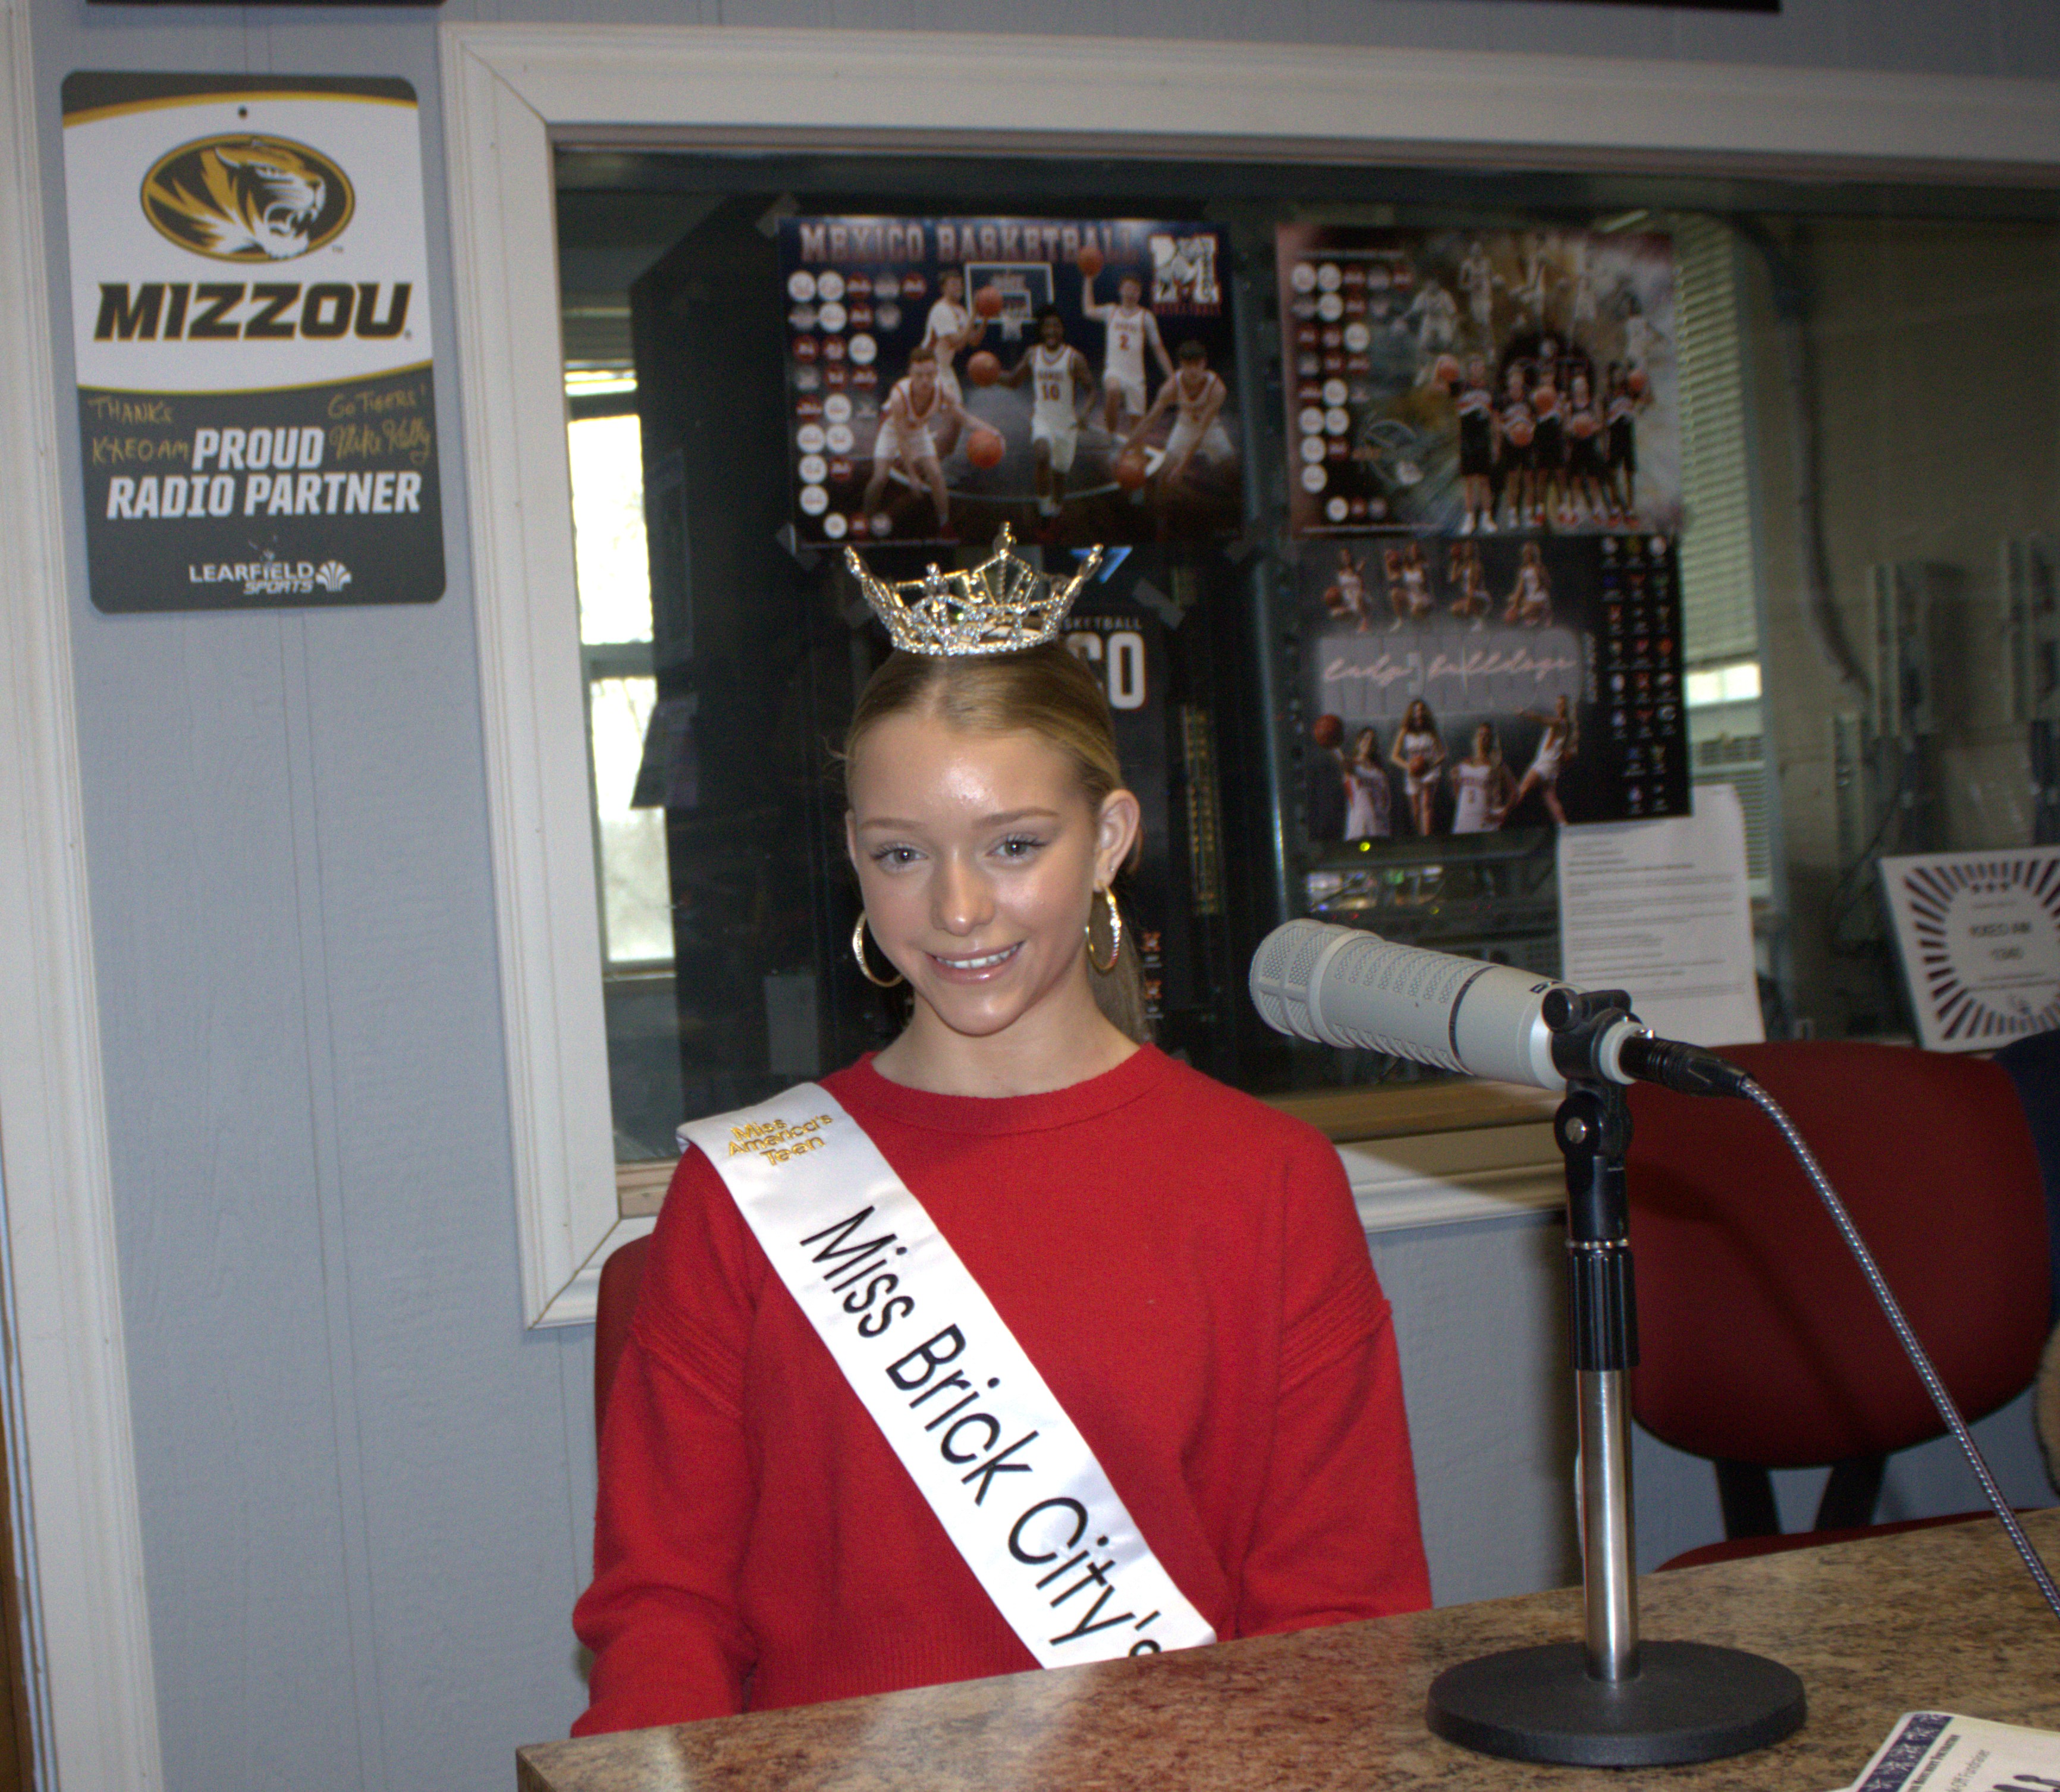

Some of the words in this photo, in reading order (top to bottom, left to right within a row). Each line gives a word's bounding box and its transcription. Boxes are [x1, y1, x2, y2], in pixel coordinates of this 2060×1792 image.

[93, 281, 413, 341] MIZZOU
[87, 396, 172, 426] THANKS
[192, 426, 325, 471] PROUD
[106, 475, 235, 520] RADIO
[243, 470, 422, 516] PARTNER
[189, 560, 315, 583] LEARFIELD
[242, 579, 314, 595] SPORTS
[728, 1115, 832, 1156] America's
[730, 1119, 787, 1141] Miss
[759, 1136, 826, 1166] Teen
[799, 1204, 916, 1339] Miss
[885, 1323, 1040, 1508] Brick
